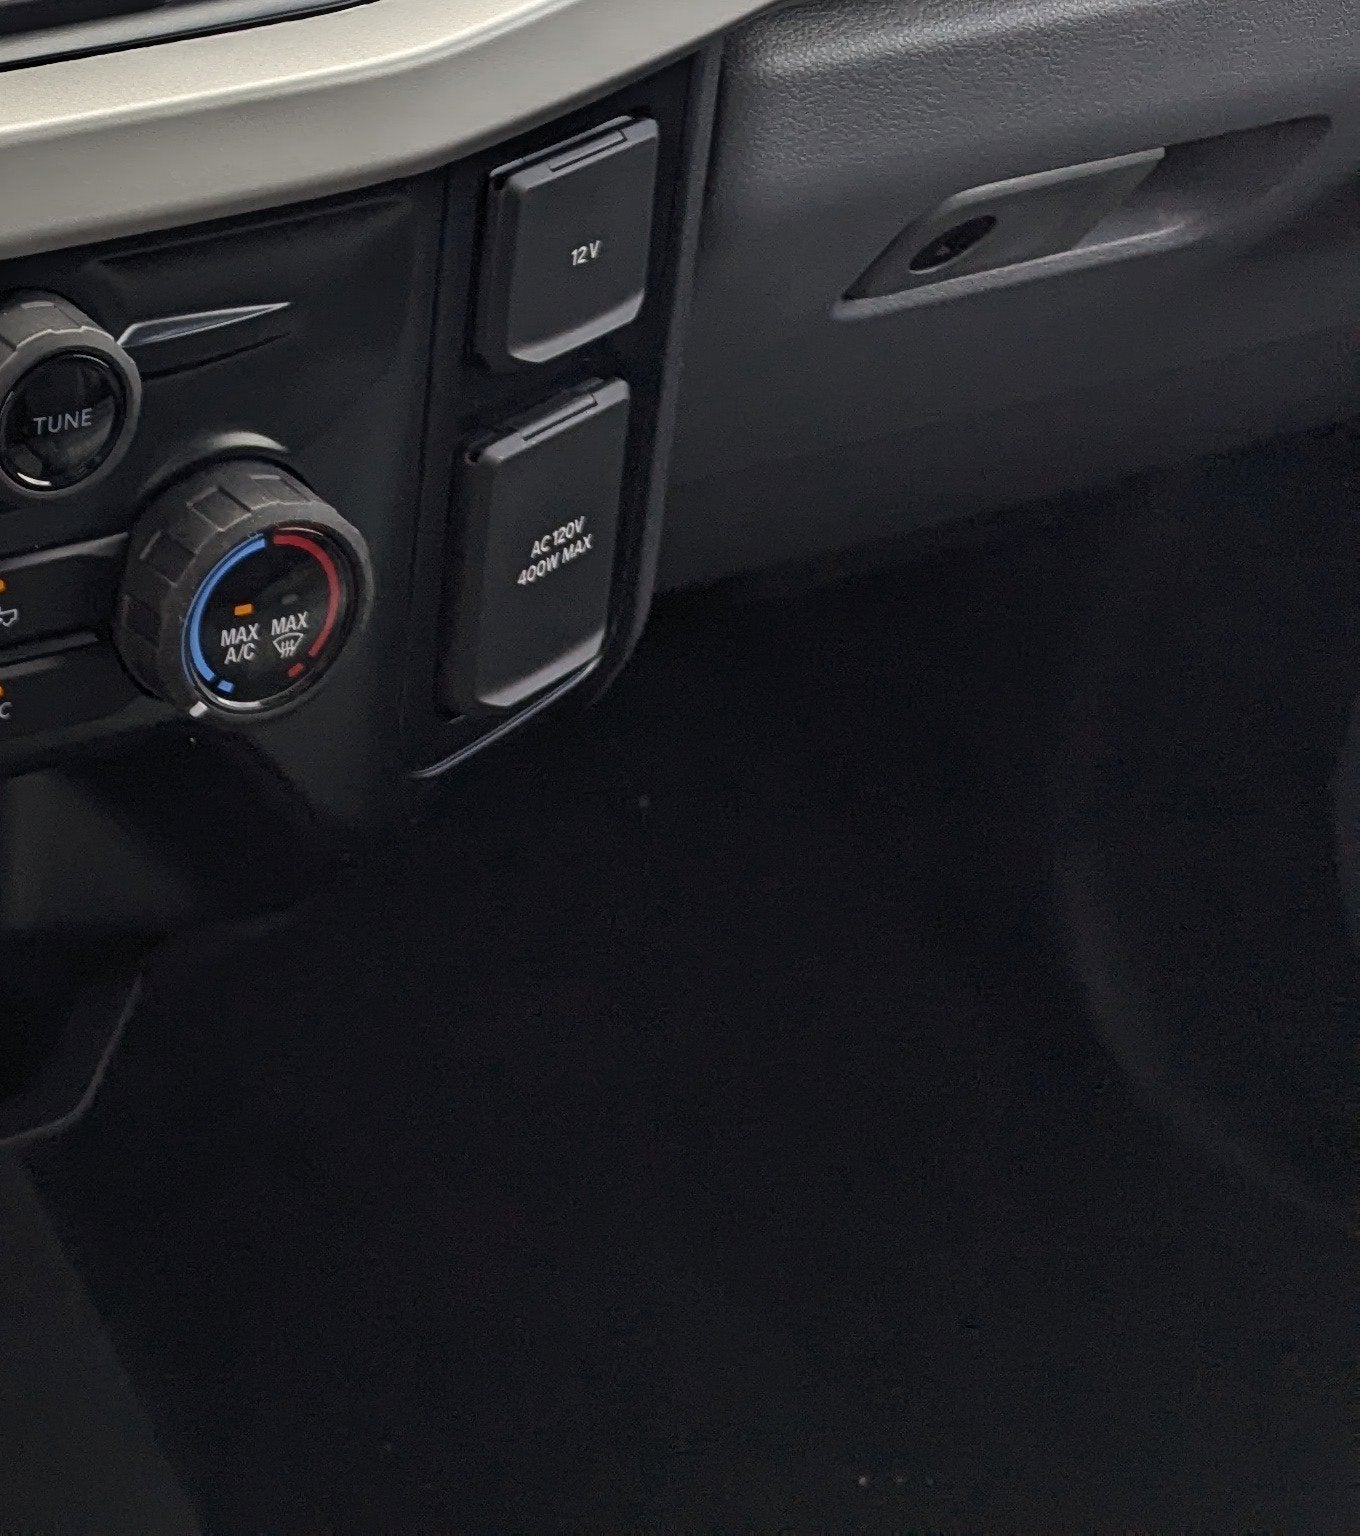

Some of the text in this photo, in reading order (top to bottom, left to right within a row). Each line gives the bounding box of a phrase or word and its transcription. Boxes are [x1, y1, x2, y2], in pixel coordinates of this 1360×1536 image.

[33, 407, 93, 435] TUNE
[530, 515, 586, 559] AC 120V
[517, 533, 593, 585] 400W MAX
[220, 623, 259, 647] MAX
[270, 610, 309, 635] MAX
[224, 642, 256, 664] A/C
